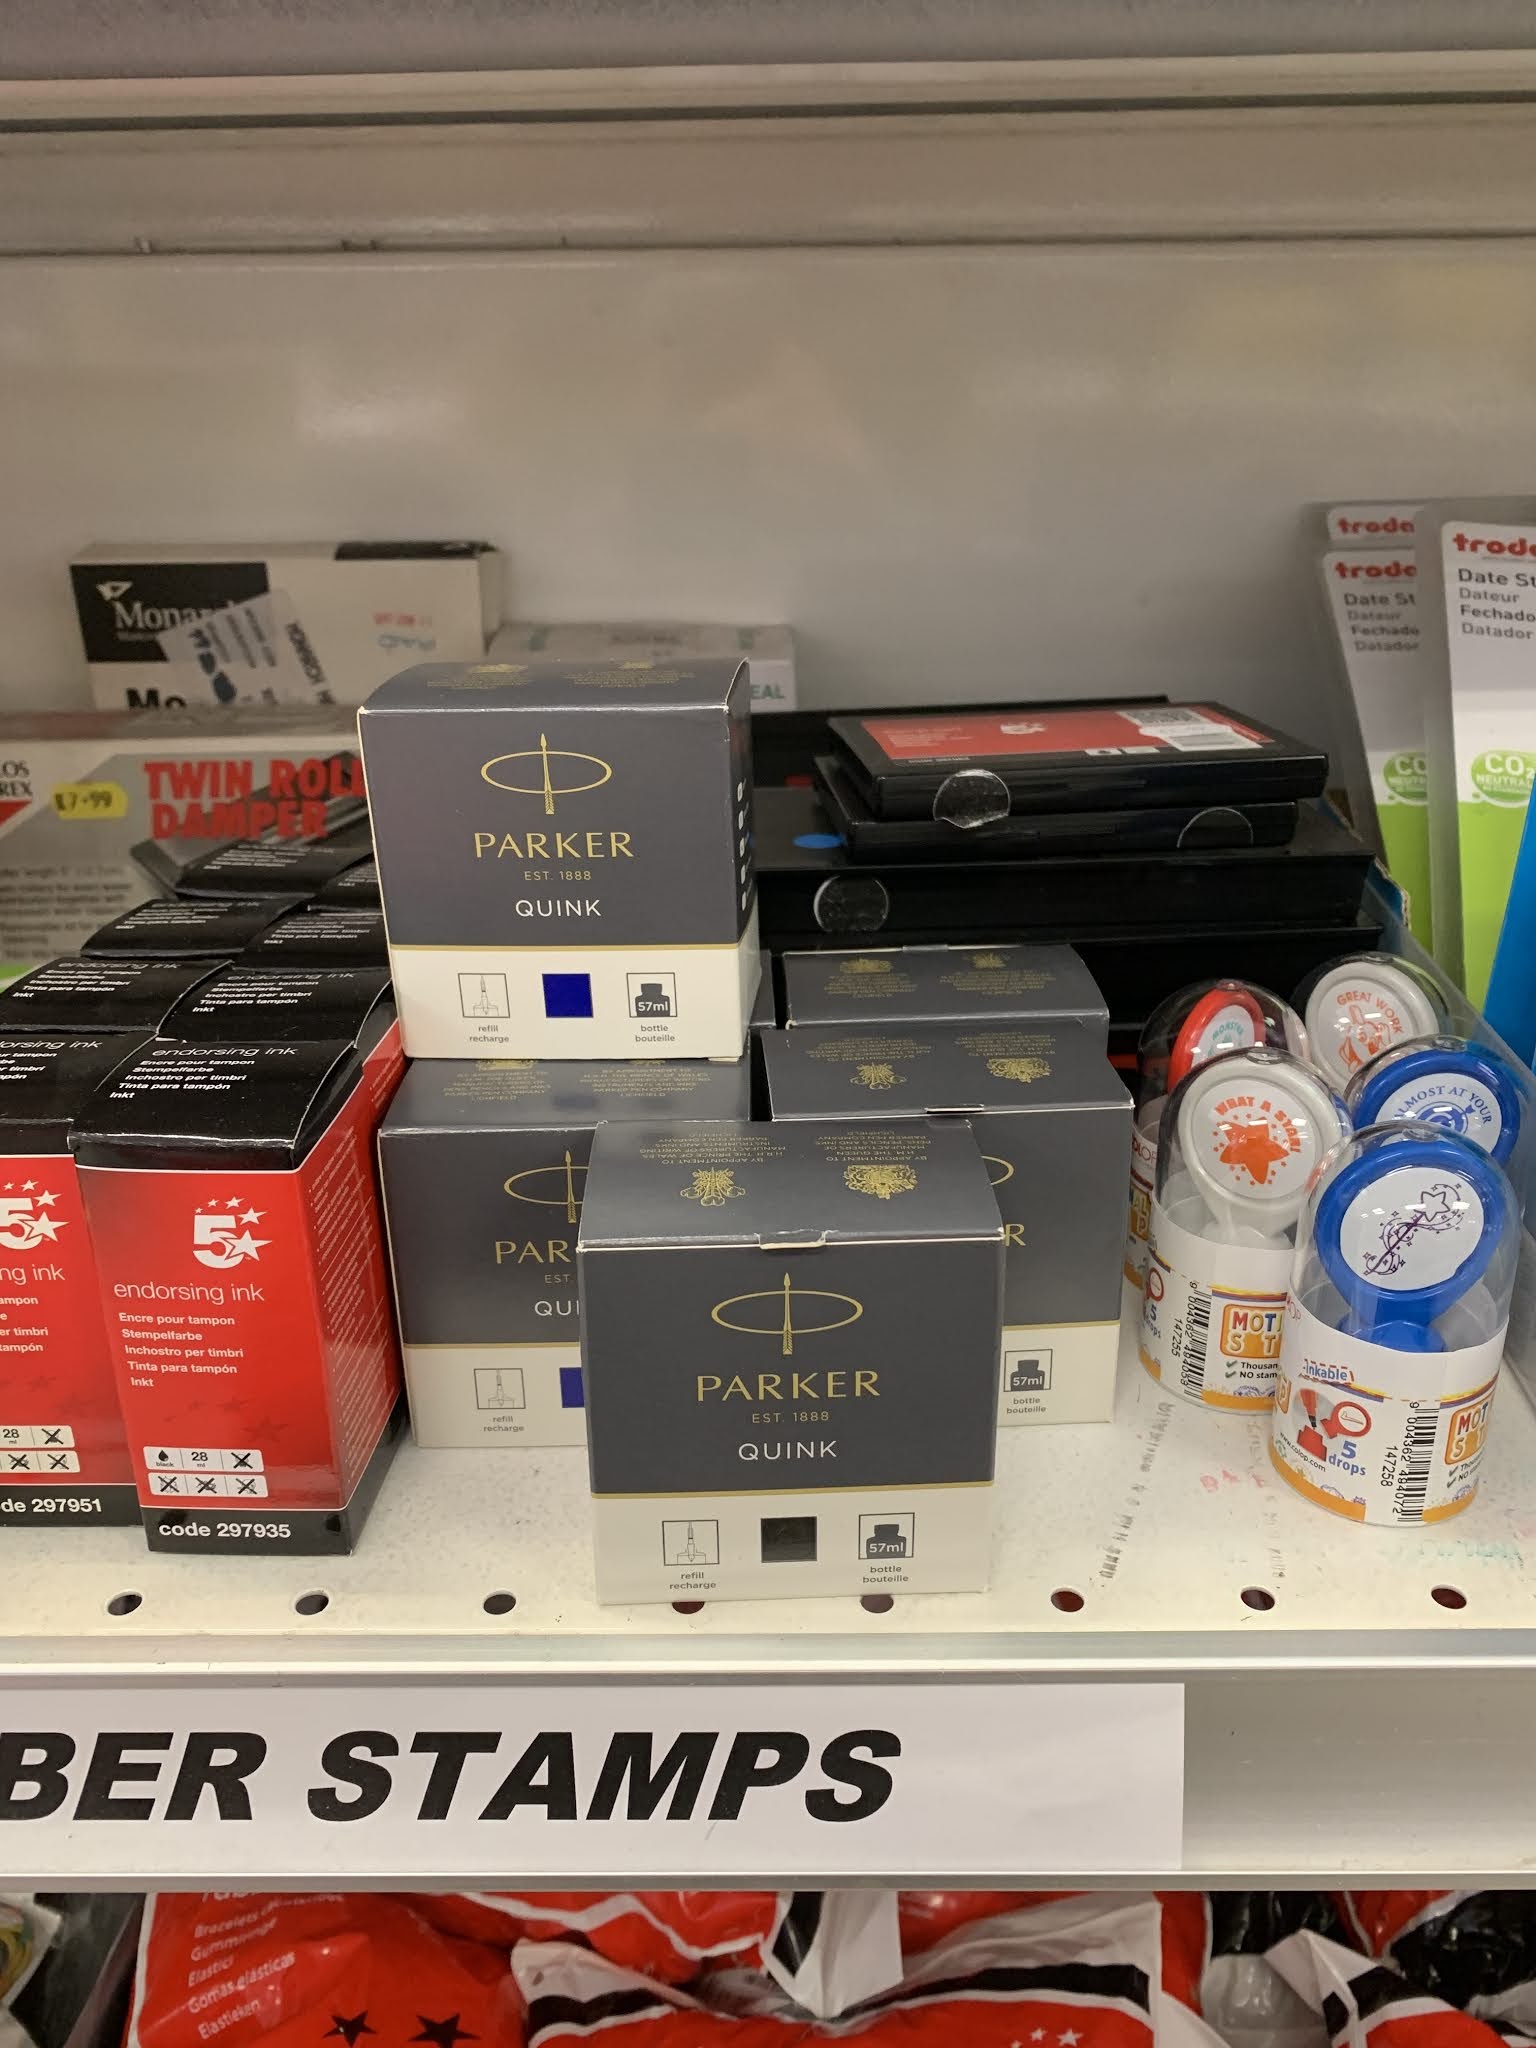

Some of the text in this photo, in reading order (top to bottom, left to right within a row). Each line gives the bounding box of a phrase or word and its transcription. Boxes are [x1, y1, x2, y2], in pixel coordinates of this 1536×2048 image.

[1458, 568, 1509, 586] Date
[1344, 593, 1389, 607] Date
[1459, 588, 1520, 604] Dateur
[144, 759, 254, 800] TWIN
[152, 801, 328, 840] DAMPER
[473, 831, 634, 859] PARKER
[524, 870, 592, 881] EST. 1888
[515, 899, 602, 919] QUINK
[226, 973, 323, 981] endorsing
[637, 1001, 669, 1013] 57ml
[1336, 990, 1404, 1033] GREAT WORK
[478, 1024, 499, 1033] refill
[640, 1023, 669, 1033] bottle
[469, 1034, 510, 1044] recharge
[634, 1033, 676, 1043] bouteille
[152, 1047, 300, 1057] endorsing ink
[132, 1066, 215, 1074] Stempelfarbe
[125, 1074, 248, 1083] Inchostro per timbri
[183, 1082, 231, 1091] tampón
[1215, 1096, 1255, 1116] WHAT
[1448, 1086, 1468, 1098] AT
[1469, 1092, 1494, 1125] YOUR
[31, 1263, 66, 1281] ink
[113, 1281, 265, 1305] endorsing ink
[118, 1312, 235, 1328] Encre pour tampon
[13, 1326, 49, 1336] timbri
[121, 1328, 203, 1342] Stempelfarbe
[1171, 1318, 1183, 1358] 147255
[125, 1345, 244, 1360] Inchostro per timbri
[128, 1360, 238, 1376] Tinta para tampón
[1012, 1376, 1043, 1387] 57ml
[1239, 1371, 1254, 1379] NO
[130, 1376, 155, 1388] Inkt
[696, 1370, 881, 1402] PARKER
[1013, 1397, 1041, 1405] bottle
[1006, 1405, 1047, 1415] bouteille
[492, 1415, 514, 1424] refill
[752, 1411, 830, 1424] EST. 1888
[3, 1428, 20, 1439] 28
[483, 1424, 525, 1433] recharge
[1401, 1417, 1417, 1462] 004362
[738, 1440, 838, 1461] QUINK
[1340, 1440, 1358, 1459] 5
[191, 1451, 209, 1463] 28
[1328, 1453, 1367, 1477] drops
[1380, 1446, 1398, 1488] 147258
[31, 1498, 102, 1513] 297951
[158, 1522, 292, 1539] code 297935
[868, 1540, 904, 1553] 57ml
[869, 1564, 902, 1574] bottle
[680, 1571, 705, 1581] refill
[862, 1573, 909, 1584] bouteille
[669, 1581, 717, 1591] recharge
[306, 1728, 903, 1824] STAMPS
